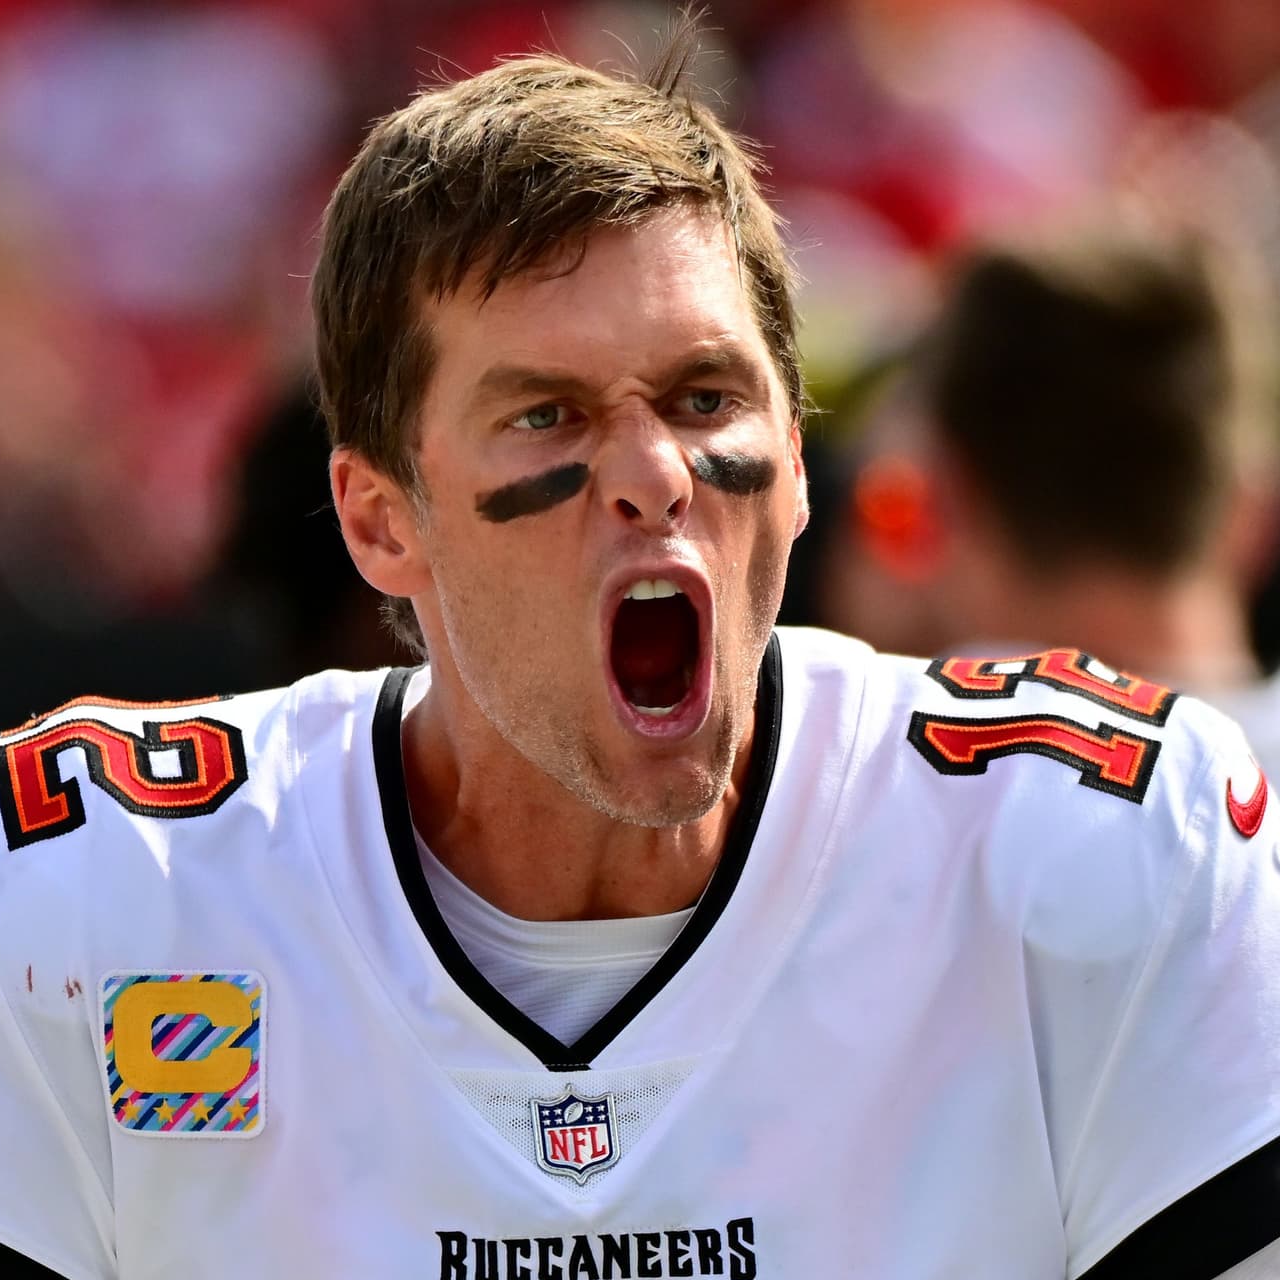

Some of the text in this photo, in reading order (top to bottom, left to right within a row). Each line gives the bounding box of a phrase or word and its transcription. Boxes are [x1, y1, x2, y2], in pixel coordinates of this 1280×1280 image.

[907, 648, 1180, 806] 12
[113, 981, 253, 1093] C
[548, 1126, 607, 1164] NFL
